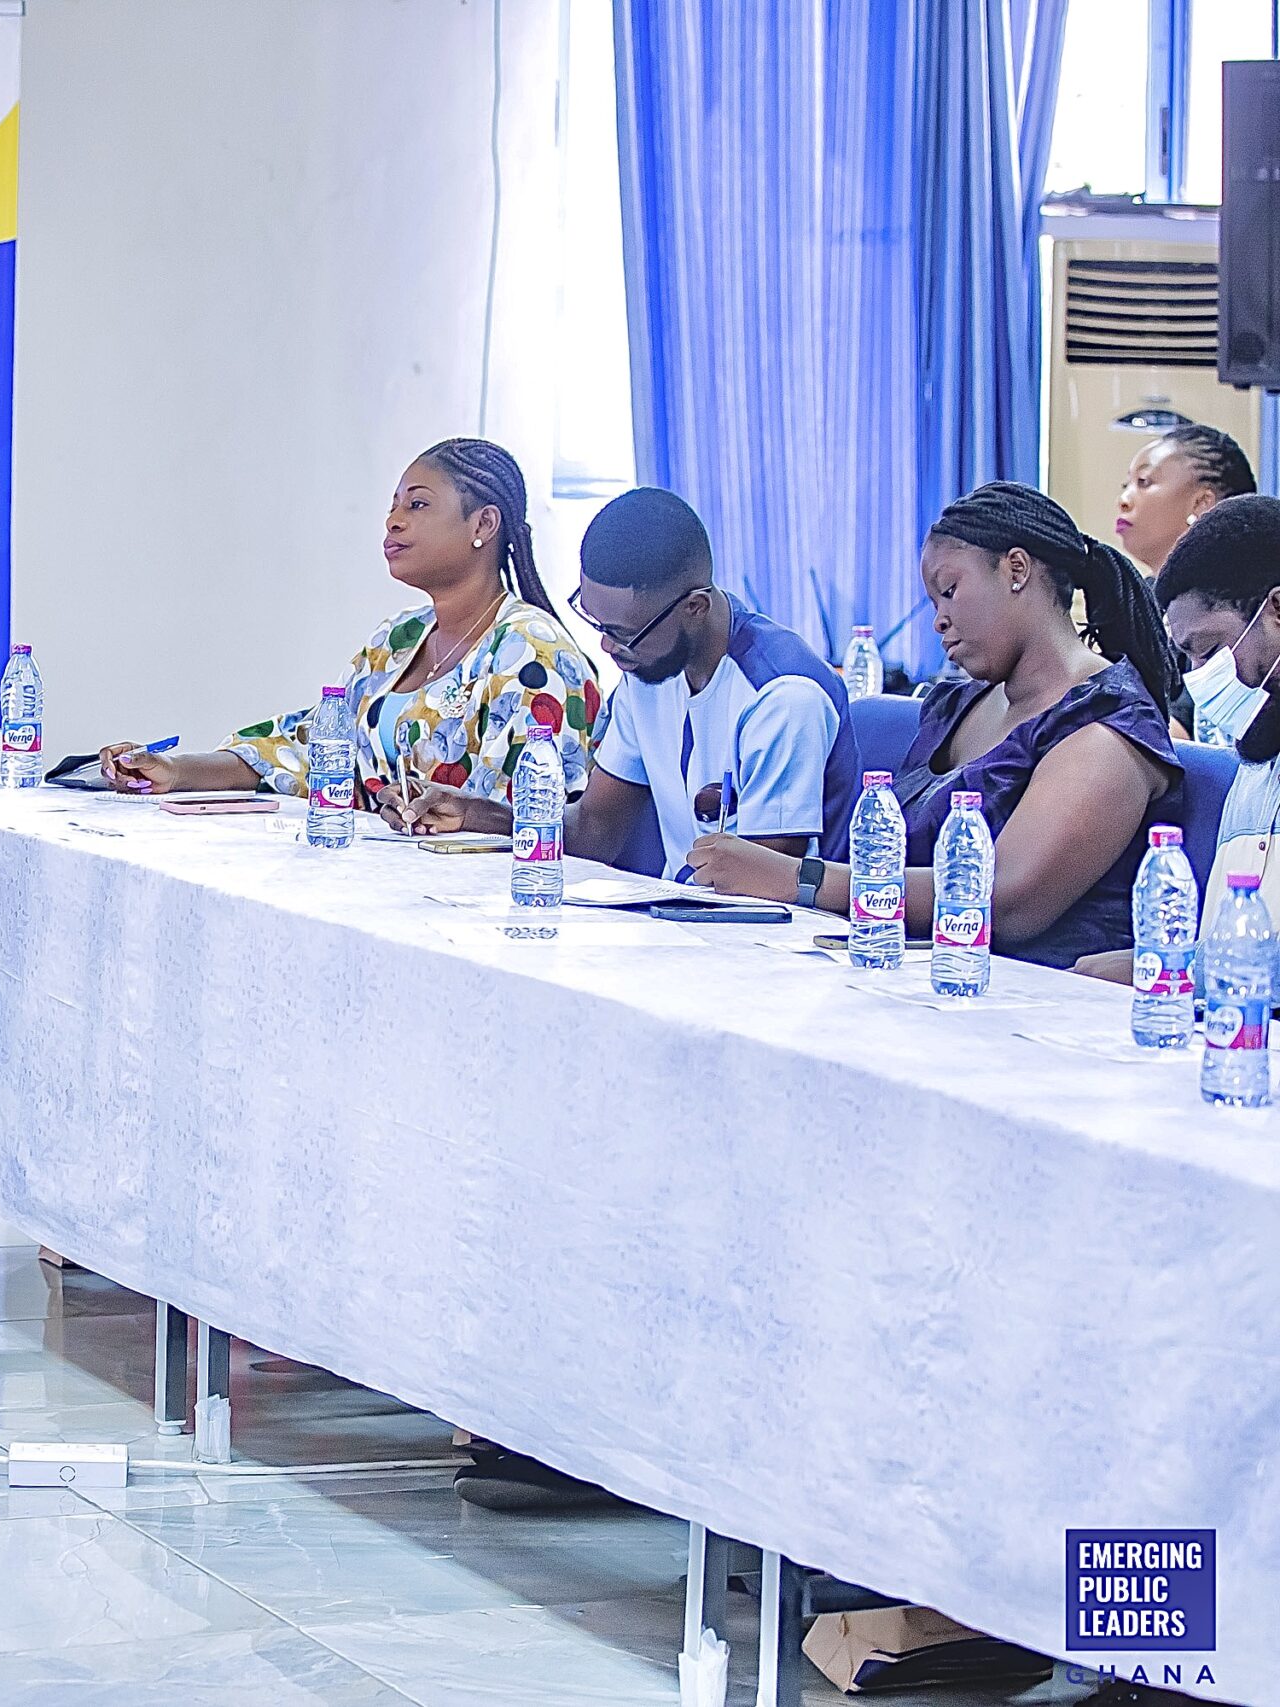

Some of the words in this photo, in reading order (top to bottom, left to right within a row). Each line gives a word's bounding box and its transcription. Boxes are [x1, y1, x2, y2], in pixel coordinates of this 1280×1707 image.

[8, 732, 33, 743] Verna
[865, 894, 897, 909] Verna
[944, 918, 978, 934] Verna
